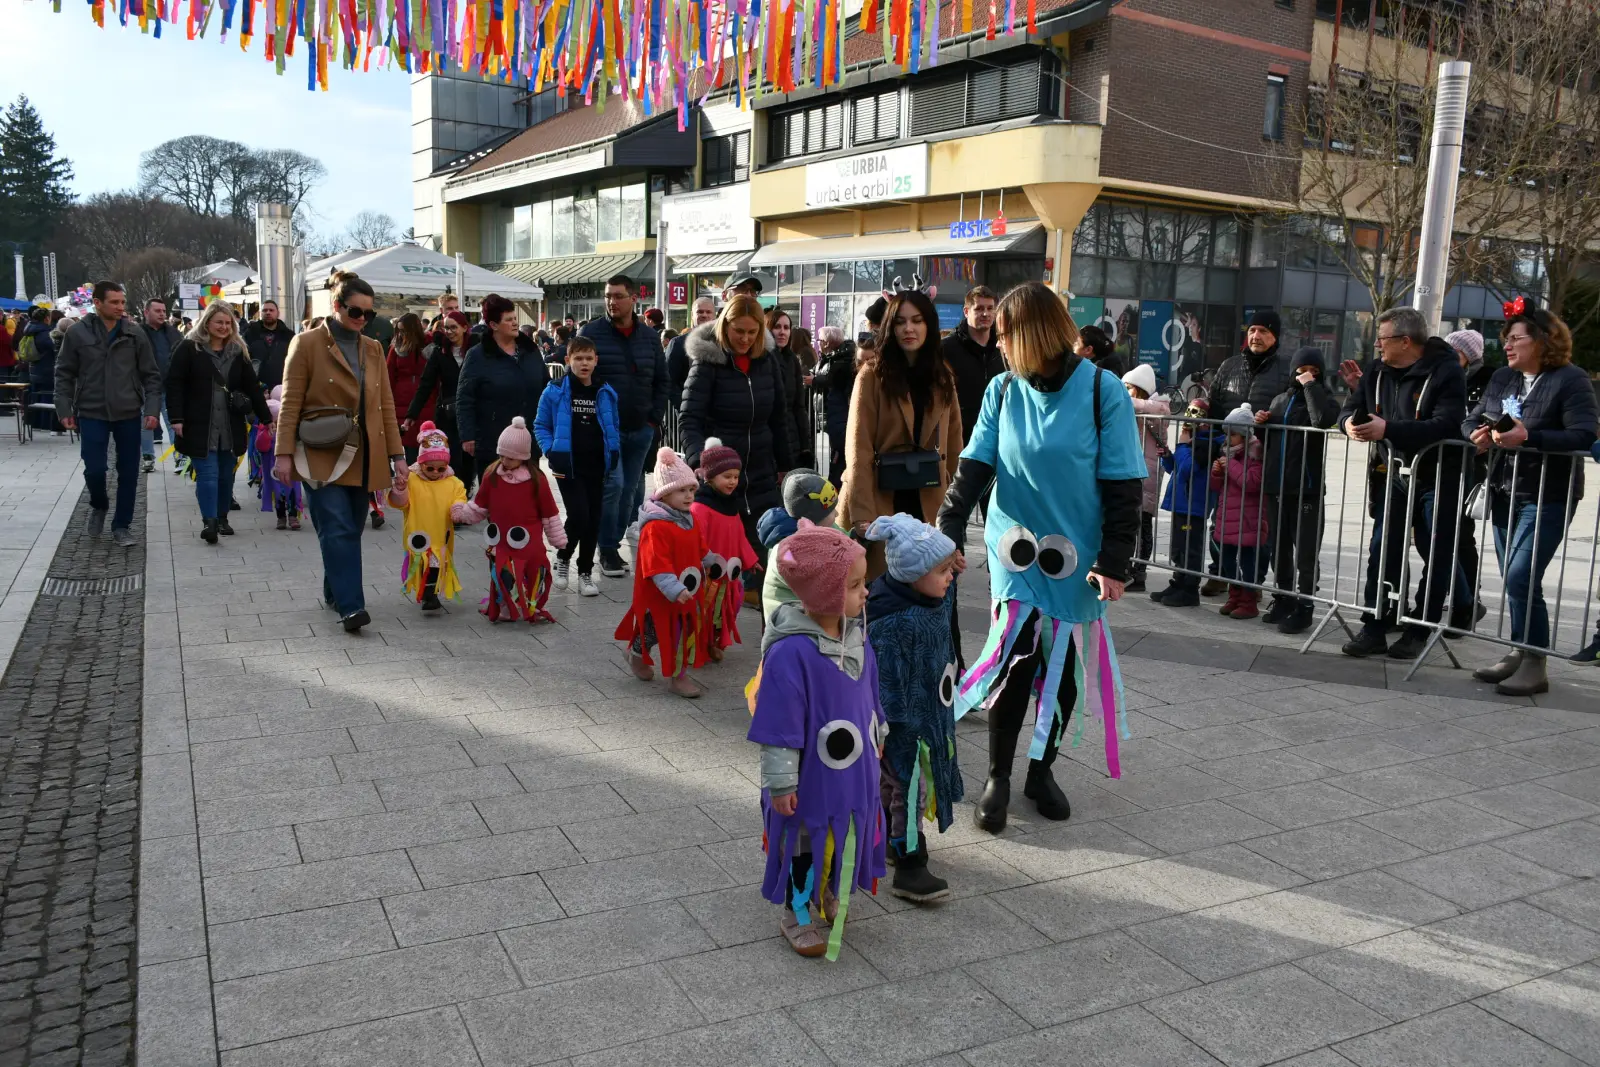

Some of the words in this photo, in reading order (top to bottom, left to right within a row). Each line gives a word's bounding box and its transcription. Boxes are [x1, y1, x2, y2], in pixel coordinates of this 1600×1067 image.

[852, 155, 888, 176] URBIA
[816, 184, 840, 204] urbi
[844, 185, 857, 201] et
[861, 178, 889, 199] orbi
[893, 175, 912, 194] 25
[950, 218, 991, 239] ERSTE
